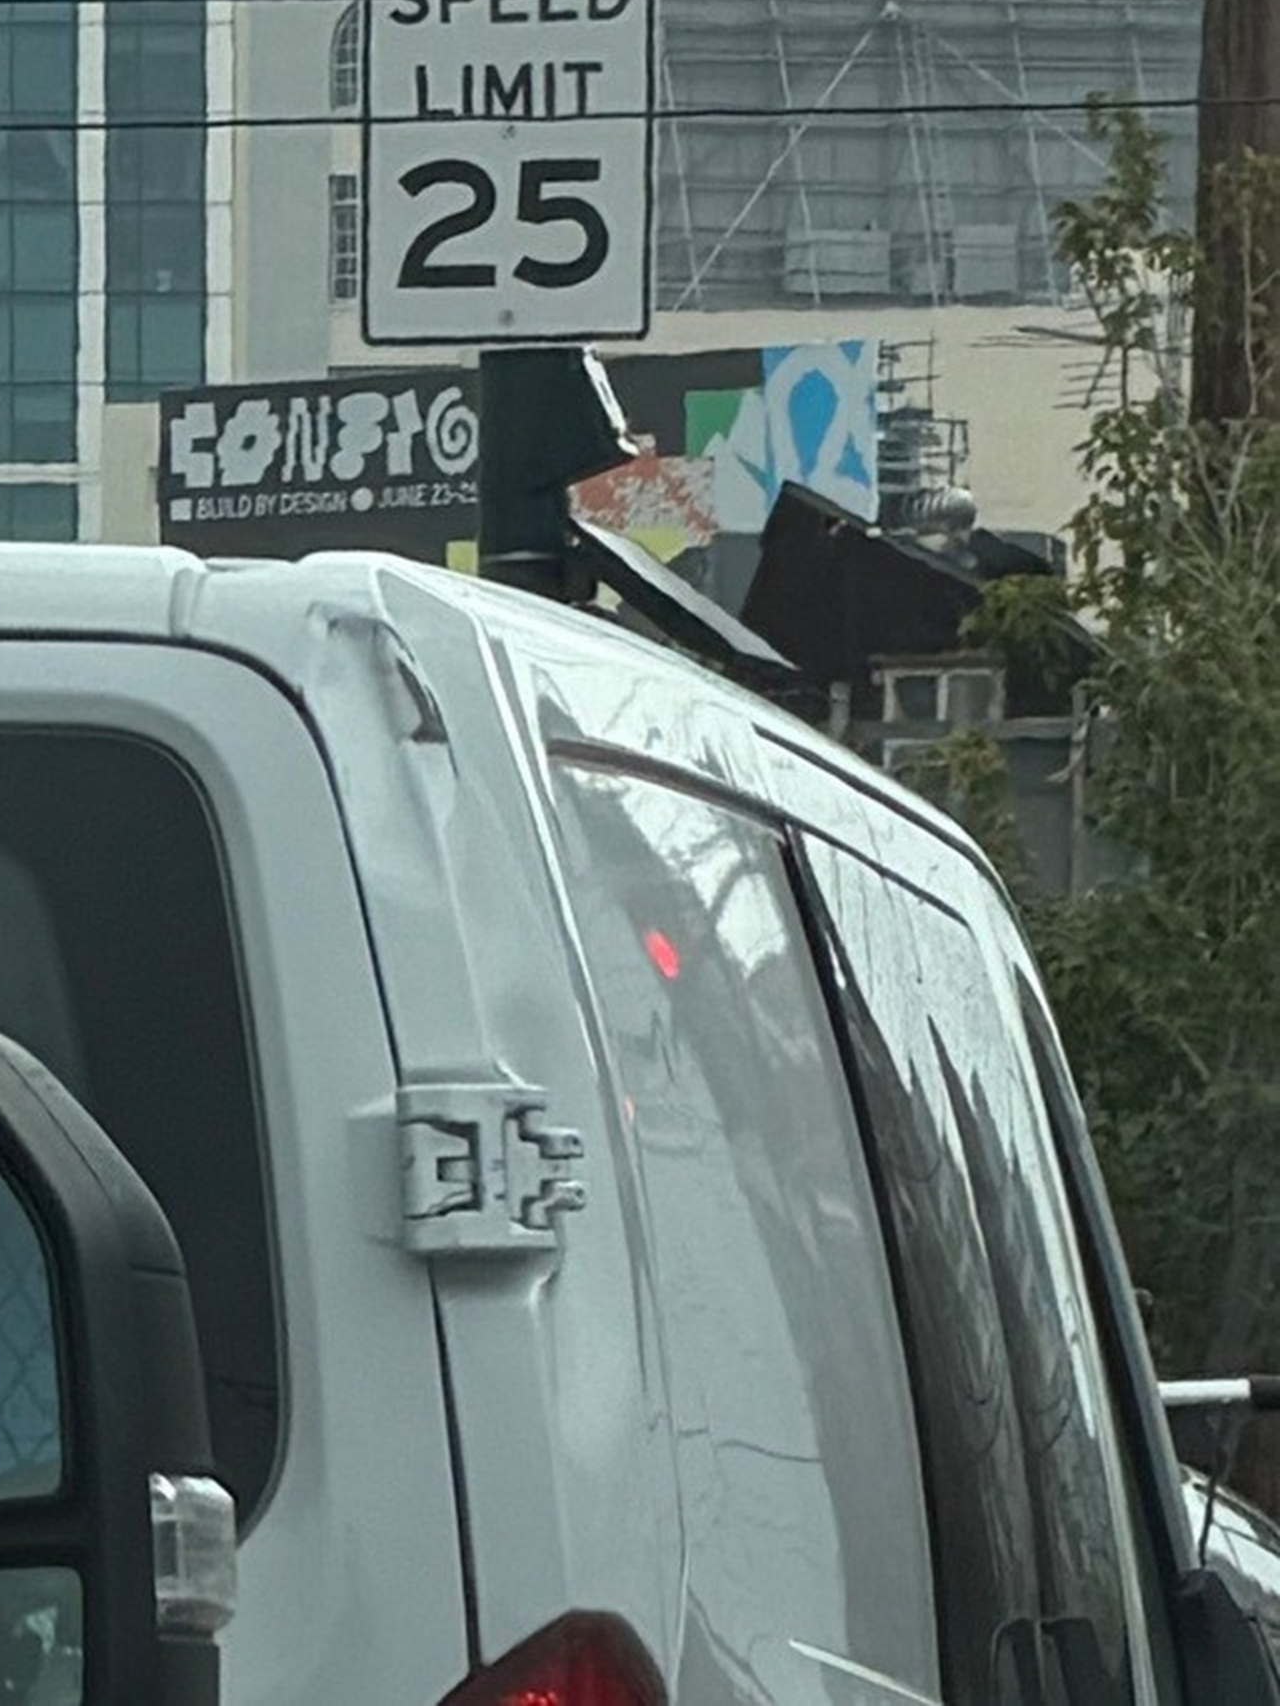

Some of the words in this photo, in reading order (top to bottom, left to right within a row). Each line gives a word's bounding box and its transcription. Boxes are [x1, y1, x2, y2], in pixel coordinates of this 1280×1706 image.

[415, 61, 603, 119] LIMIT
[396, 158, 610, 289] 25
[169, 387, 479, 488] CONFIG
[196, 495, 252, 520] BUILD
[255, 495, 277, 516] BY
[280, 490, 348, 515] DESIGN
[379, 482, 427, 508] JUNE
